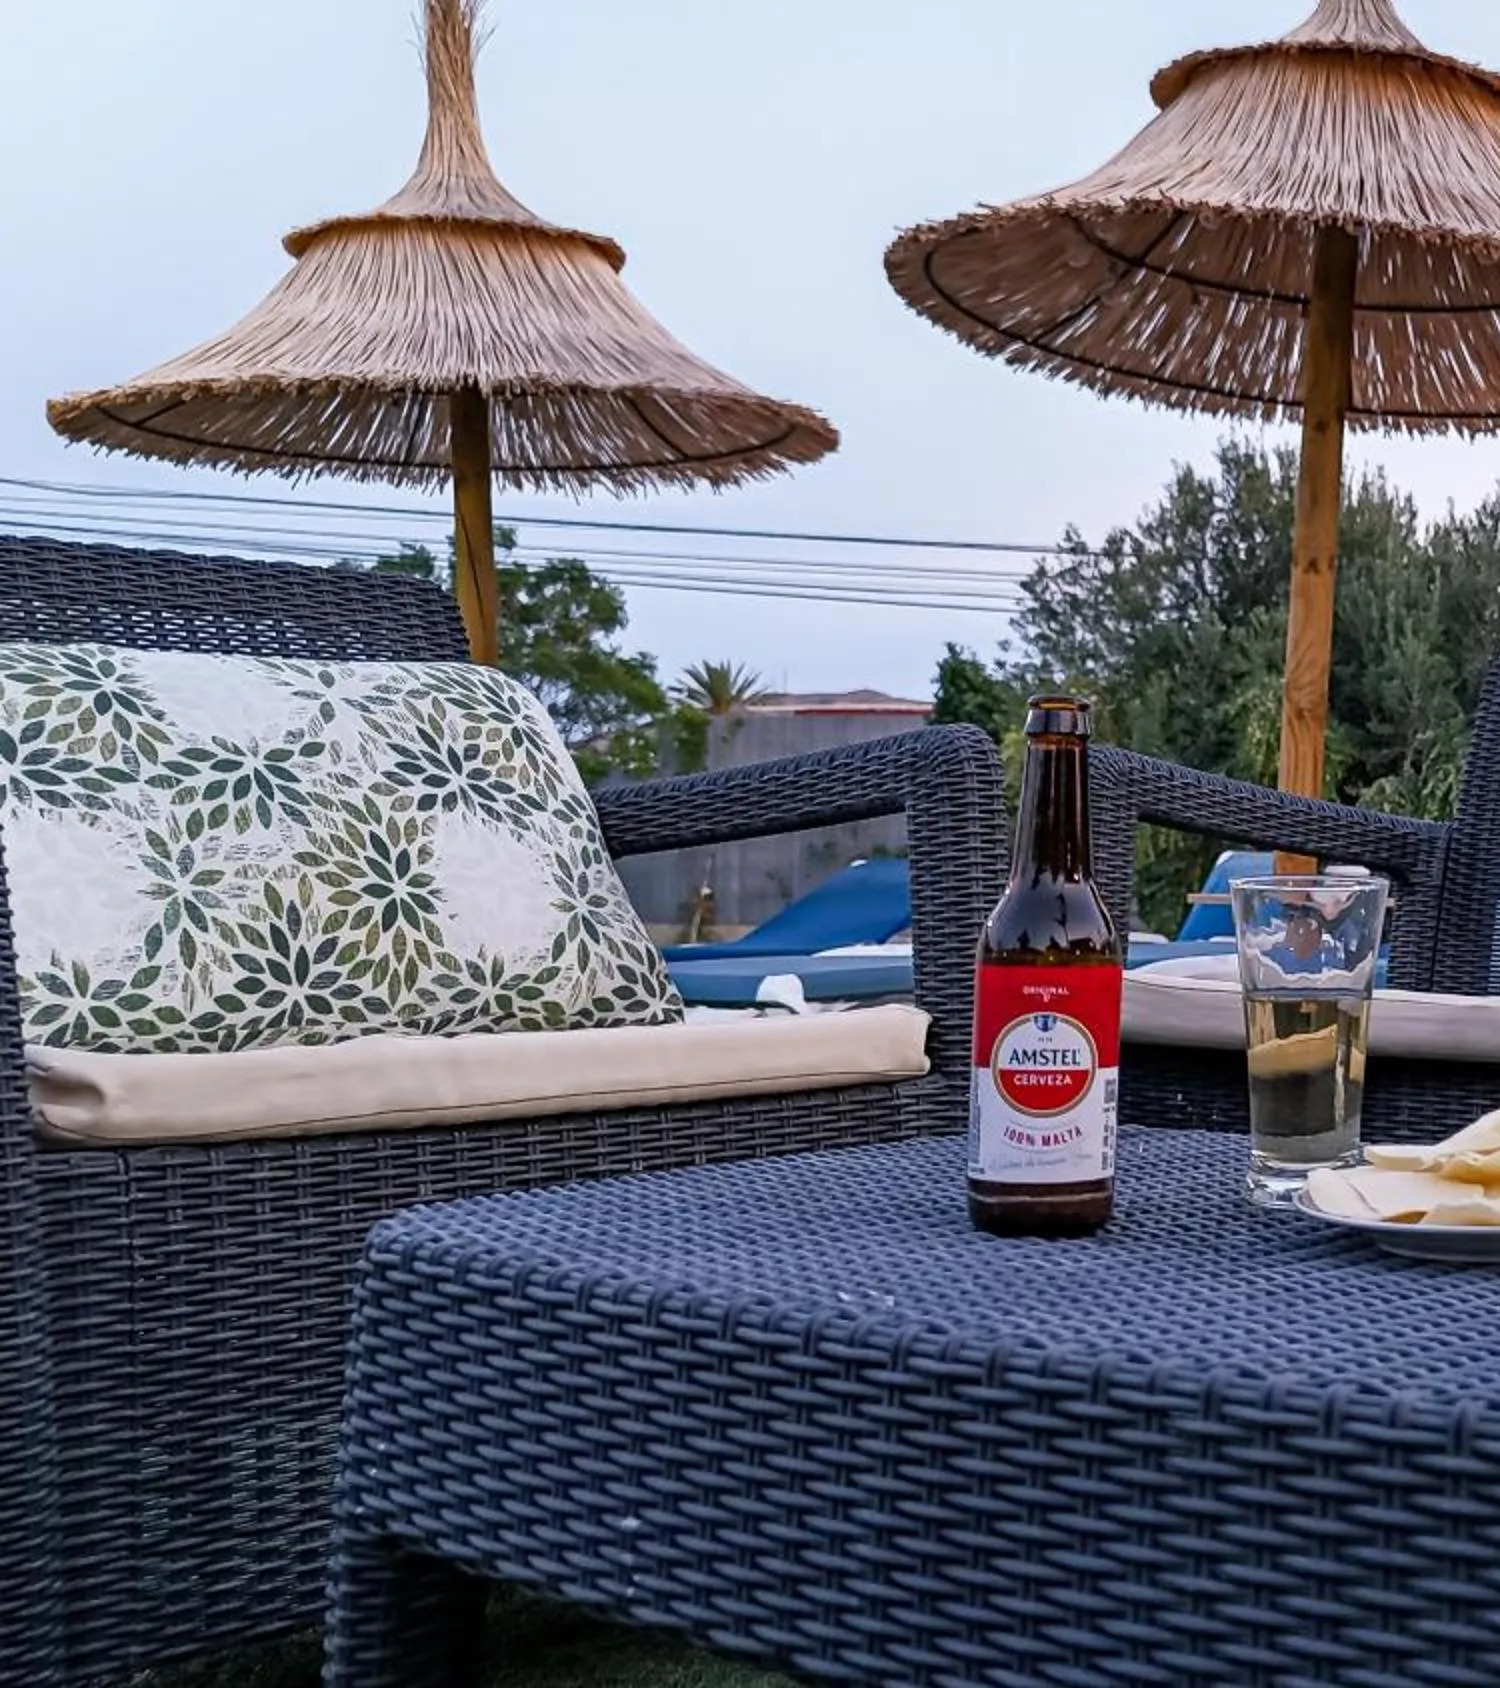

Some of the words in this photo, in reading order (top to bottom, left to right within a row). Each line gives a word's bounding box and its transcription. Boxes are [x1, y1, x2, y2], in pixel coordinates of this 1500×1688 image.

[1008, 1048, 1080, 1066] AMSTEL
[1013, 1074, 1073, 1086] CERVEZA
[1041, 1126, 1083, 1147] MALTA
